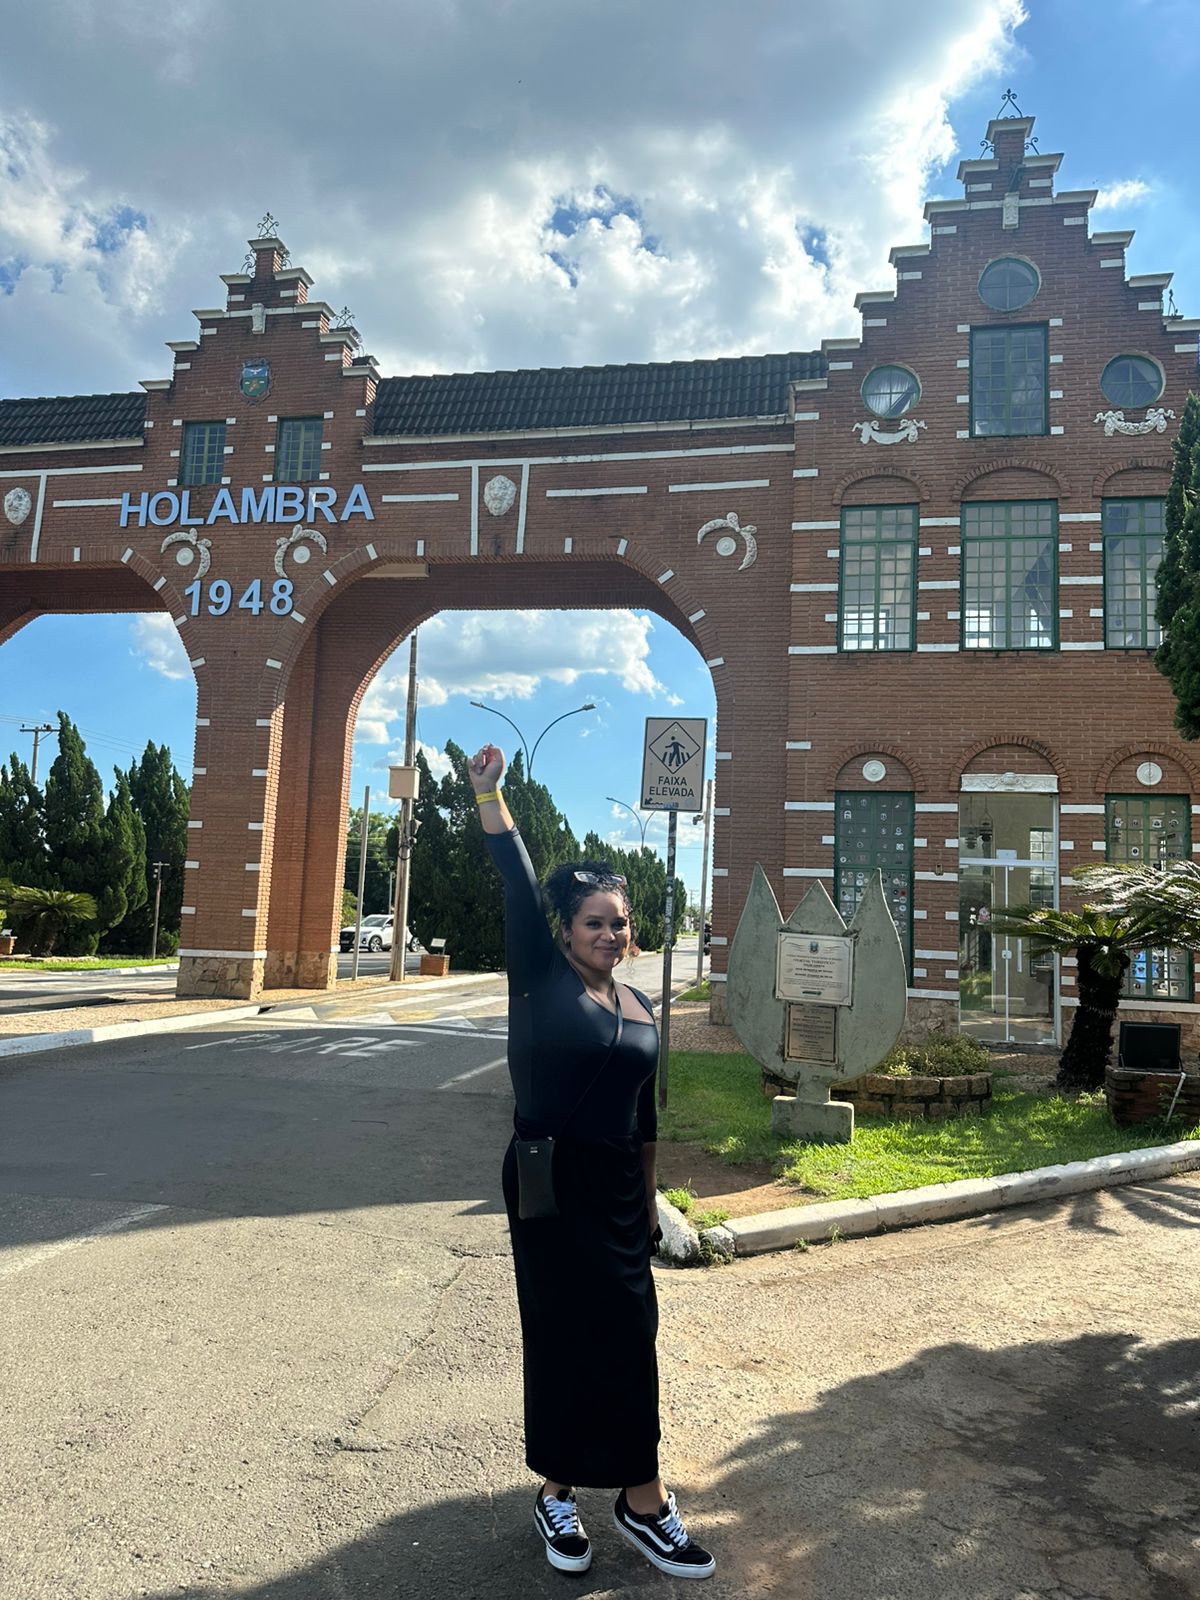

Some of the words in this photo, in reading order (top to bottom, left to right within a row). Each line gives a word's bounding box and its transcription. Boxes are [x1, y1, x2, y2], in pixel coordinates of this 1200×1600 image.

[119, 483, 375, 527] HOLAMBRA
[185, 578, 294, 616] 1948
[649, 786, 695, 797] ELEVADA
[658, 776, 687, 786] FAIXA
